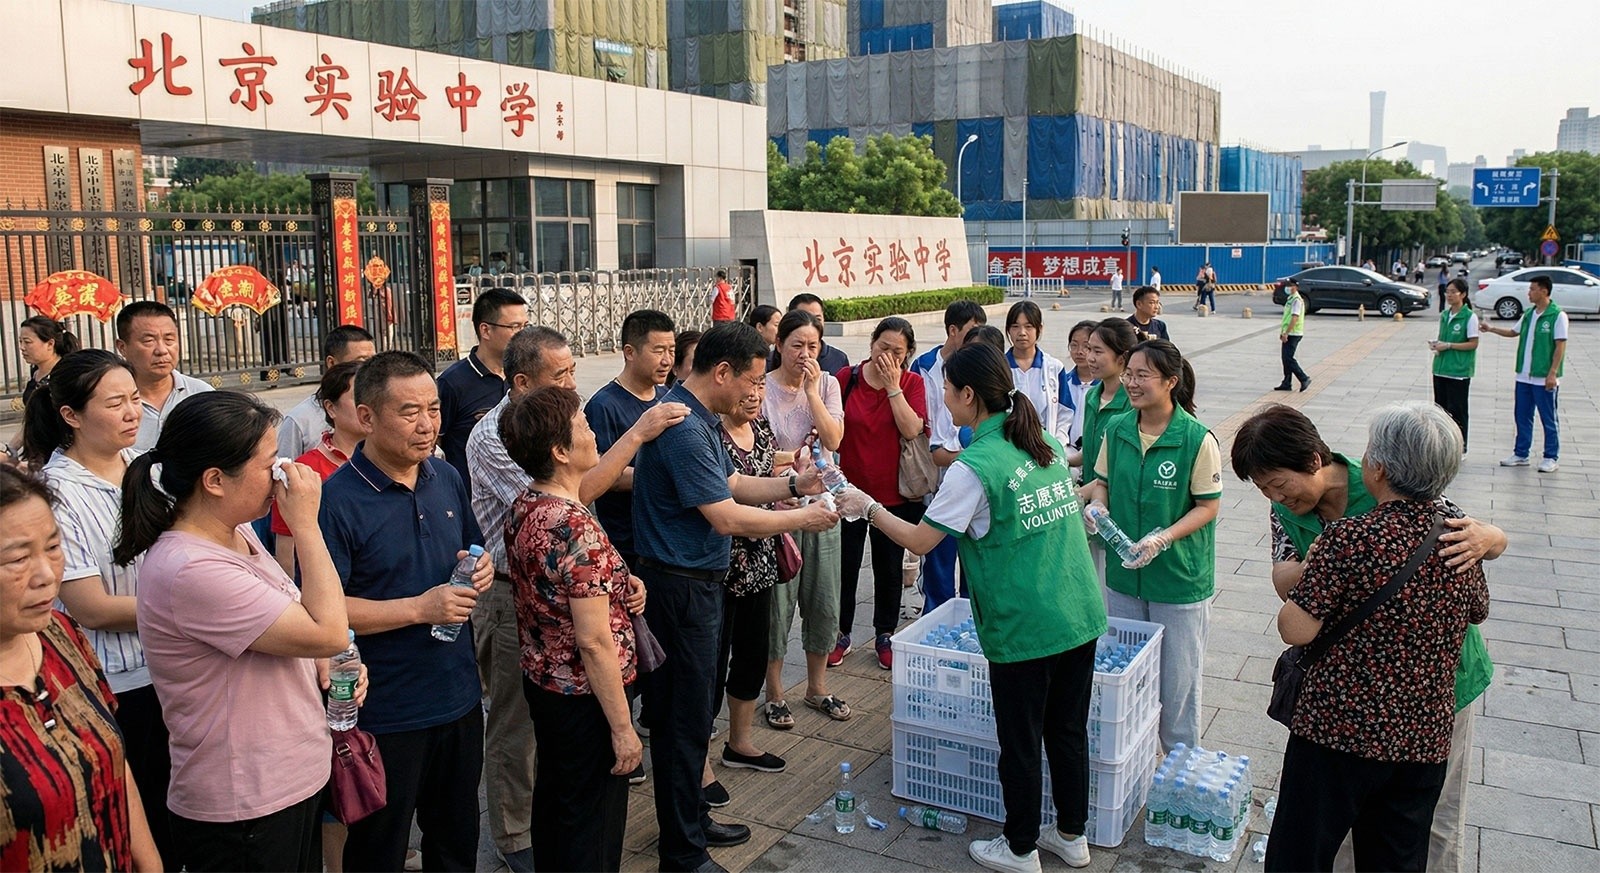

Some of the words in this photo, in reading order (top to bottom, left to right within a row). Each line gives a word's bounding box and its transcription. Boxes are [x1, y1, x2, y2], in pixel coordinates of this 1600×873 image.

[128, 32, 537, 138] 北京实验中学
[803, 236, 951, 288] 北京实验中学
